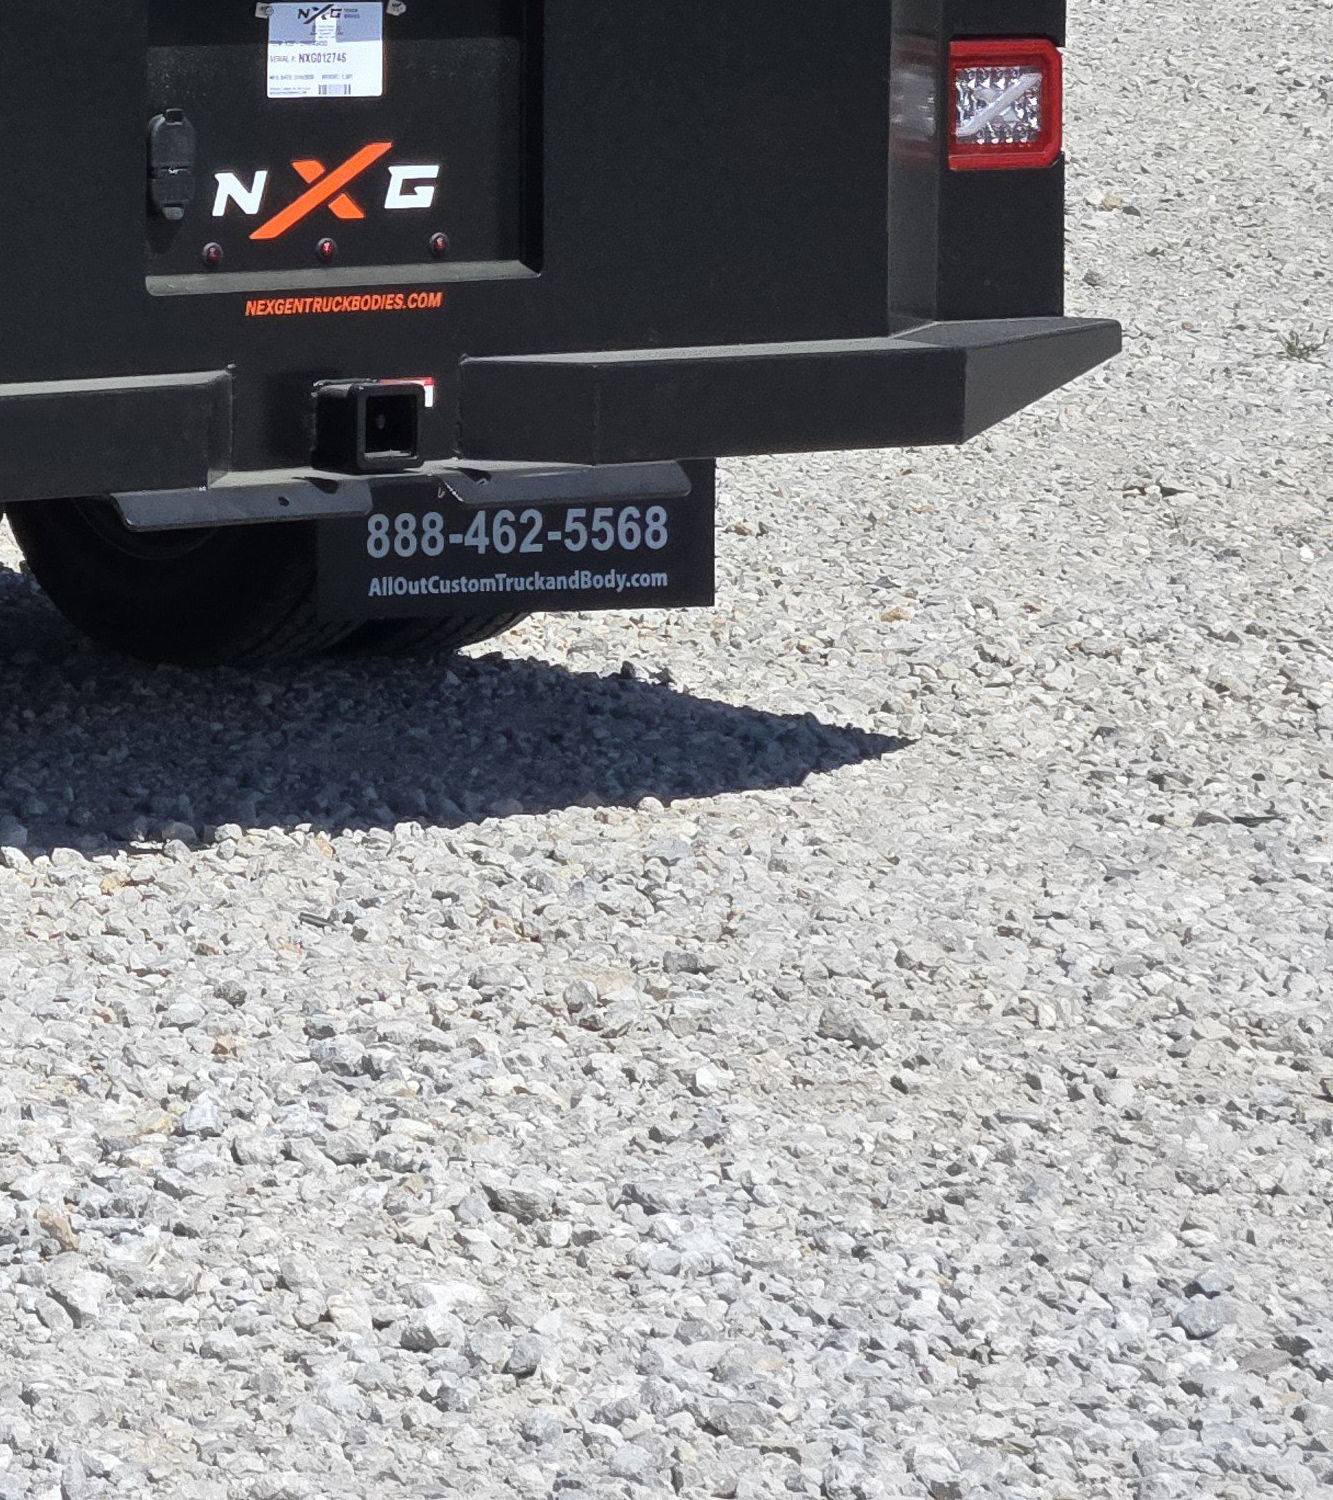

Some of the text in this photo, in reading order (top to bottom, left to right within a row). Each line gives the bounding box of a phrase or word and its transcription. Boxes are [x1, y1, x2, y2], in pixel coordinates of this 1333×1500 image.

[297, 4, 342, 24] NXG
[212, 141, 440, 240] NXG
[244, 291, 443, 317] NEXGENTRUCKBODIES.COM
[366, 504, 669, 559] 888-462-5568
[368, 568, 668, 598] AllOutCustomTruckandBody.com
